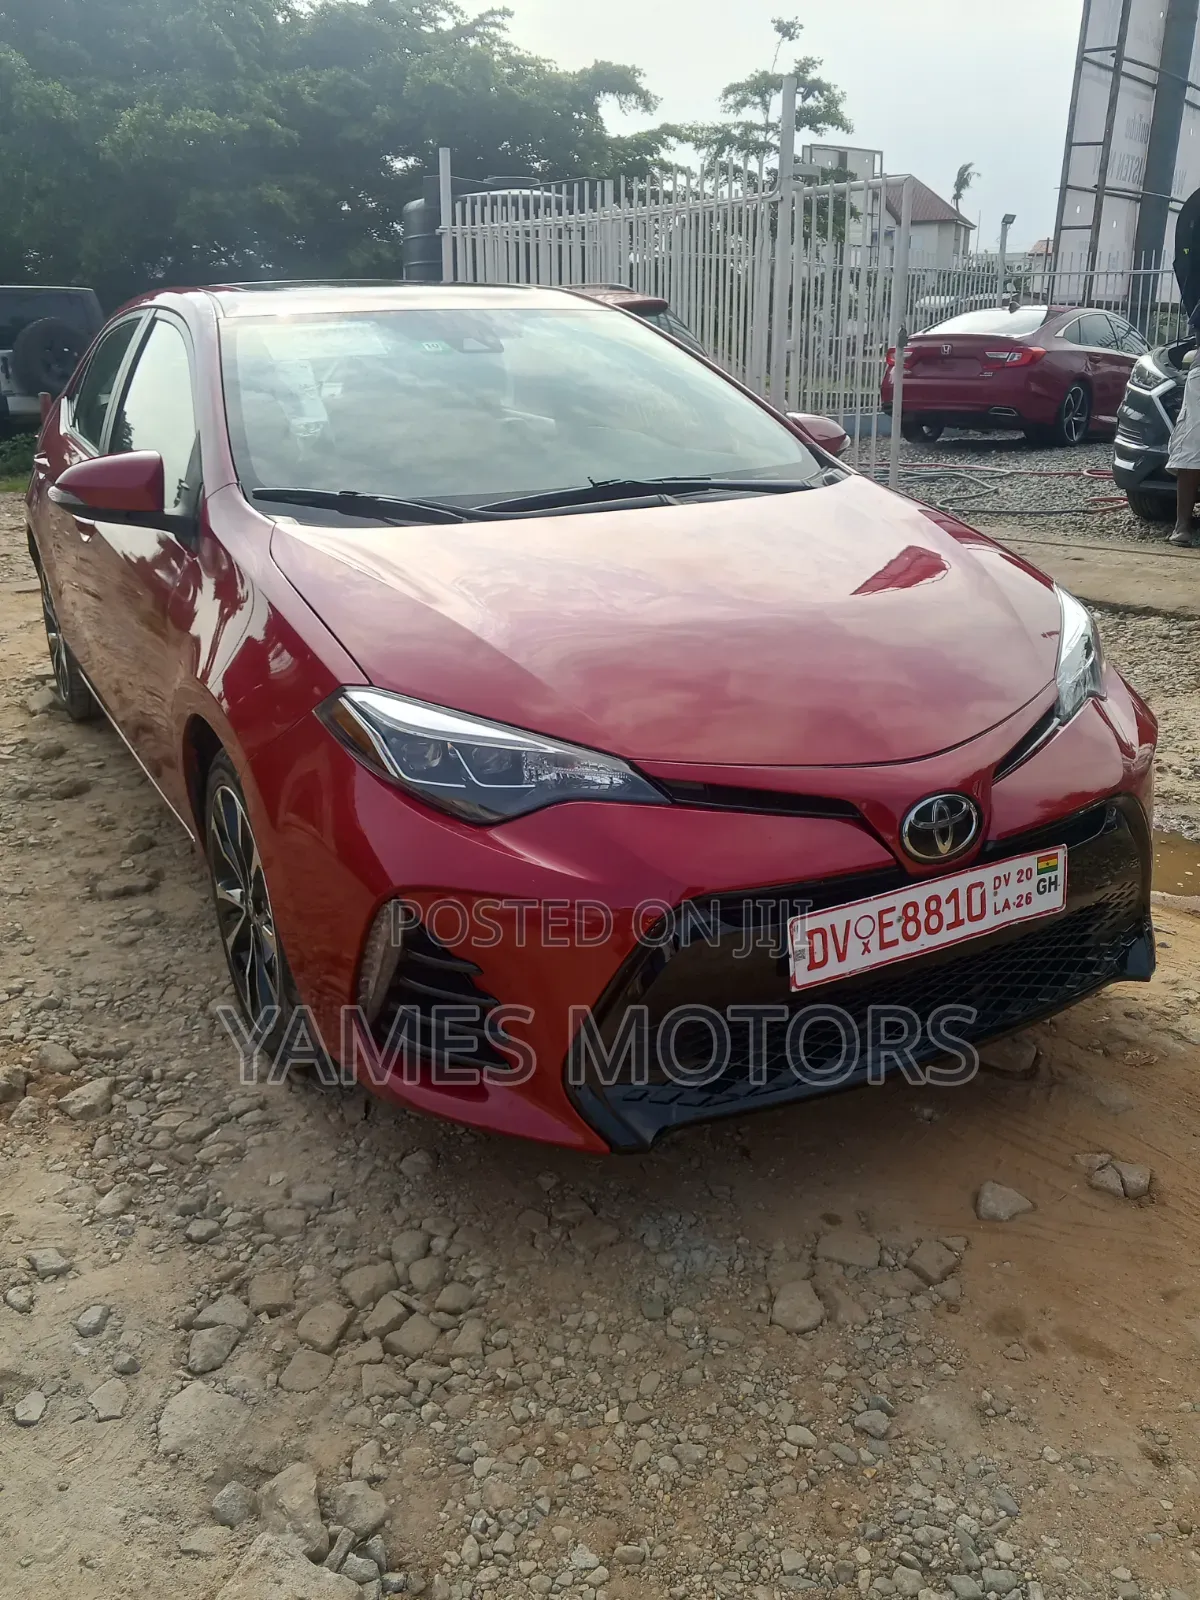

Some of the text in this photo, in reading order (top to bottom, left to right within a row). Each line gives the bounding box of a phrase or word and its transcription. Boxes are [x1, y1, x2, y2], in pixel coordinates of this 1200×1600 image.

[993, 867, 1033, 890] DV 20
[1036, 874, 1059, 895] GH
[806, 881, 987, 971] DV E8810
